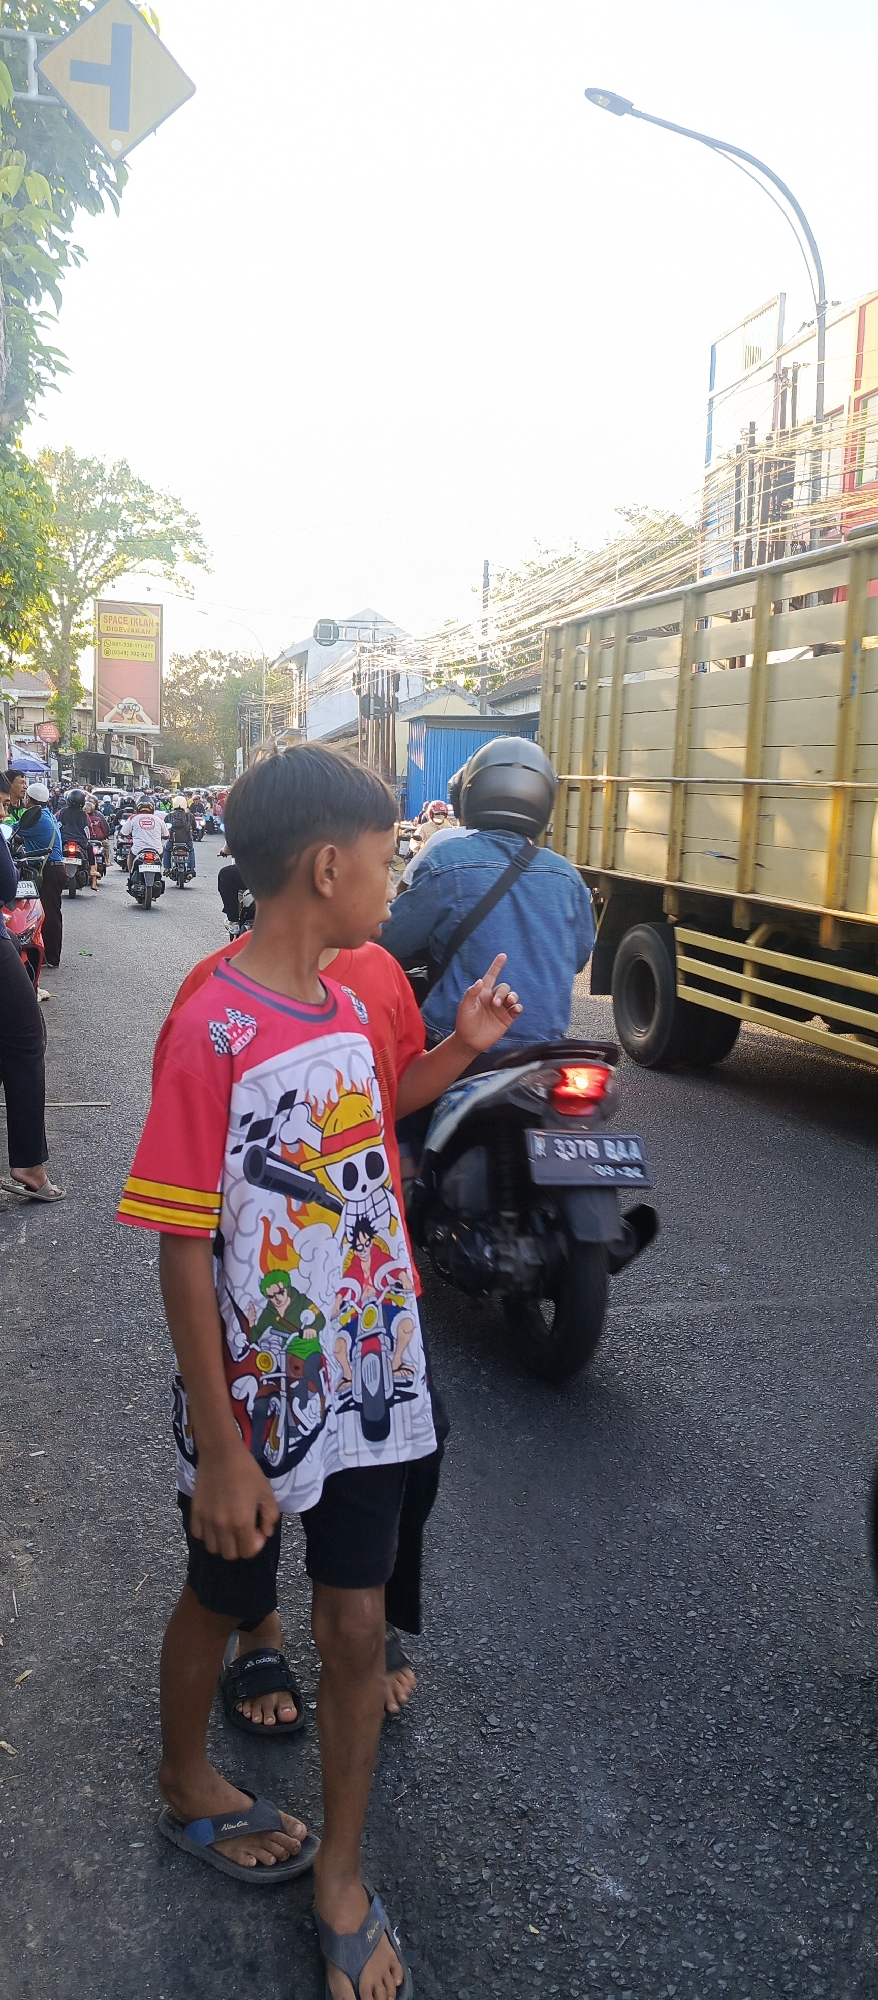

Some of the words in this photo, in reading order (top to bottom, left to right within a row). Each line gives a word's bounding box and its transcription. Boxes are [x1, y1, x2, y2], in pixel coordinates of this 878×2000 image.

[103, 614, 129, 625] SPACE
[130, 617, 154, 628] IKLAN
[106, 625, 151, 635] DISEWAKAN
[255, 1656, 278, 1665] adidas
